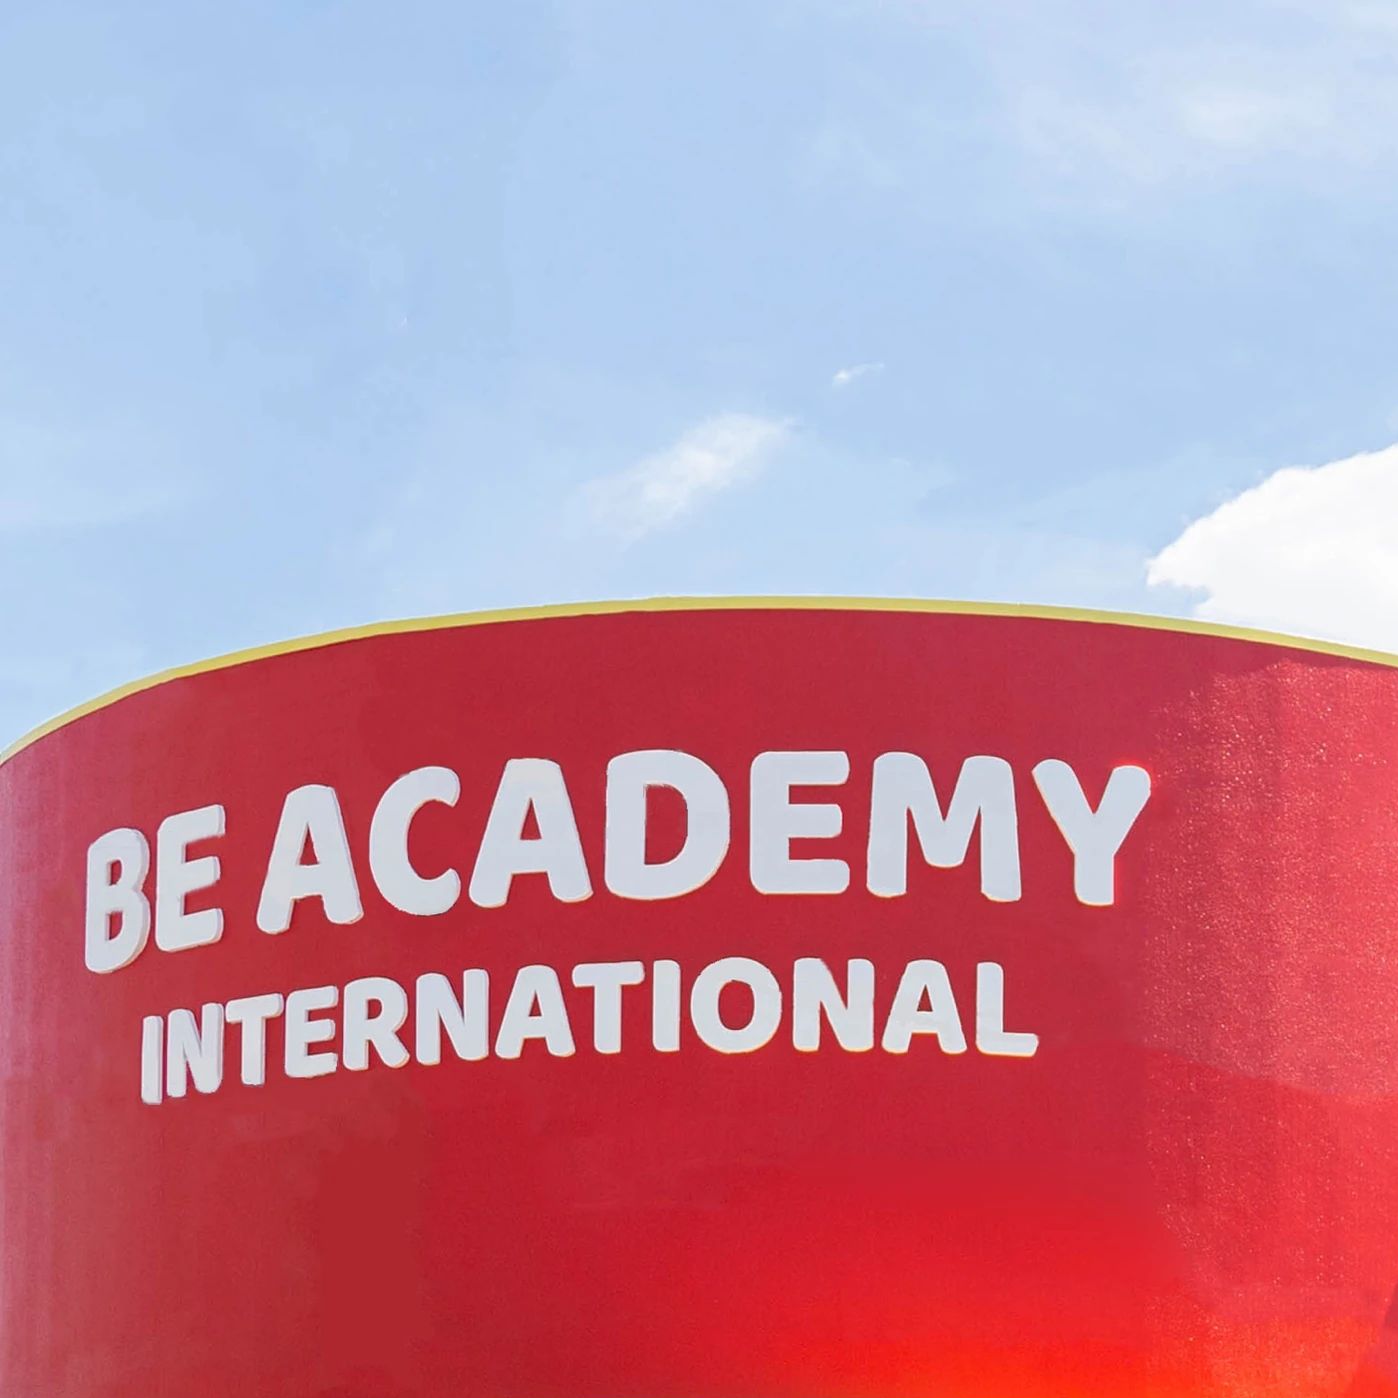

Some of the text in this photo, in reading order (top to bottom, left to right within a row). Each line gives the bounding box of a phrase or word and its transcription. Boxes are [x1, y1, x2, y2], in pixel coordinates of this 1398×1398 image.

[85, 749, 1152, 974] BE ACADEMY
[140, 956, 1039, 1105] INTERNATIONAL
